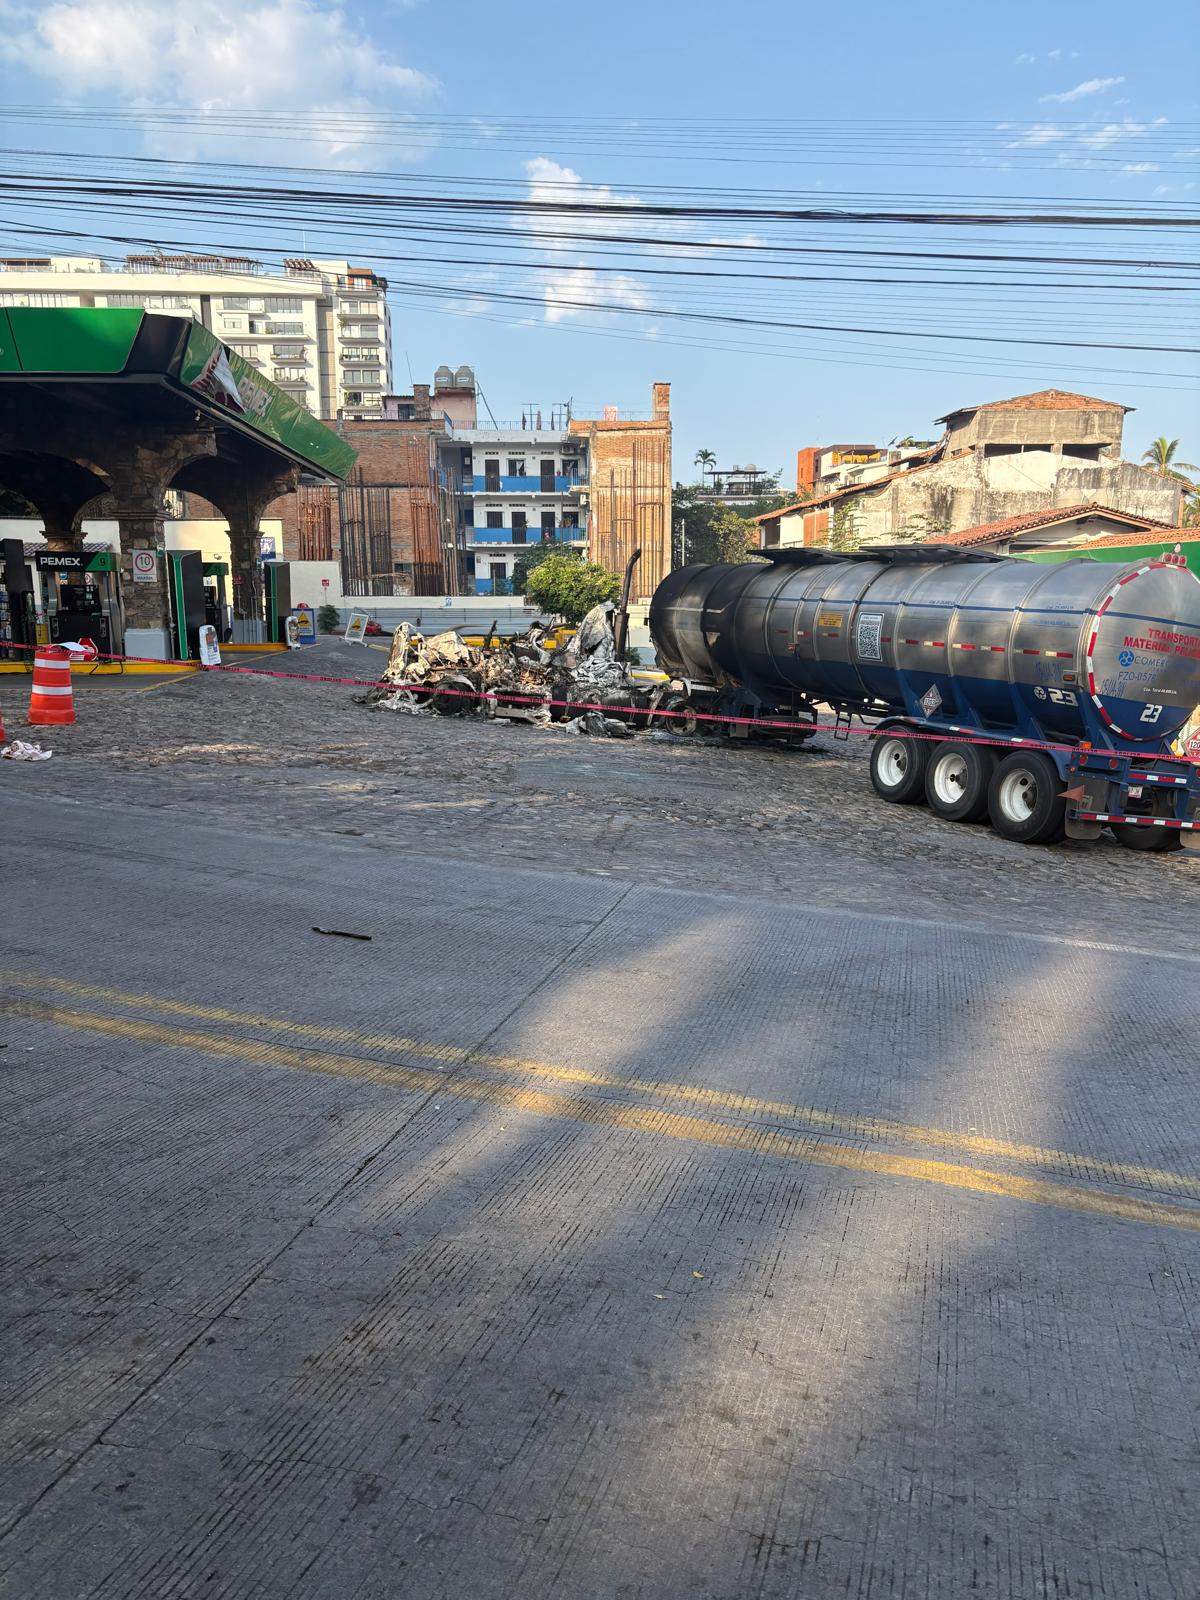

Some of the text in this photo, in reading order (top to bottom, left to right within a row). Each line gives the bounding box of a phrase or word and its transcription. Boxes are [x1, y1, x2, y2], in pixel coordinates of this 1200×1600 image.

[40, 557, 80, 566] PEMEX
[139, 556, 151, 567] 10
[1048, 687, 1079, 707] 23
[1140, 703, 1163, 723] 23
